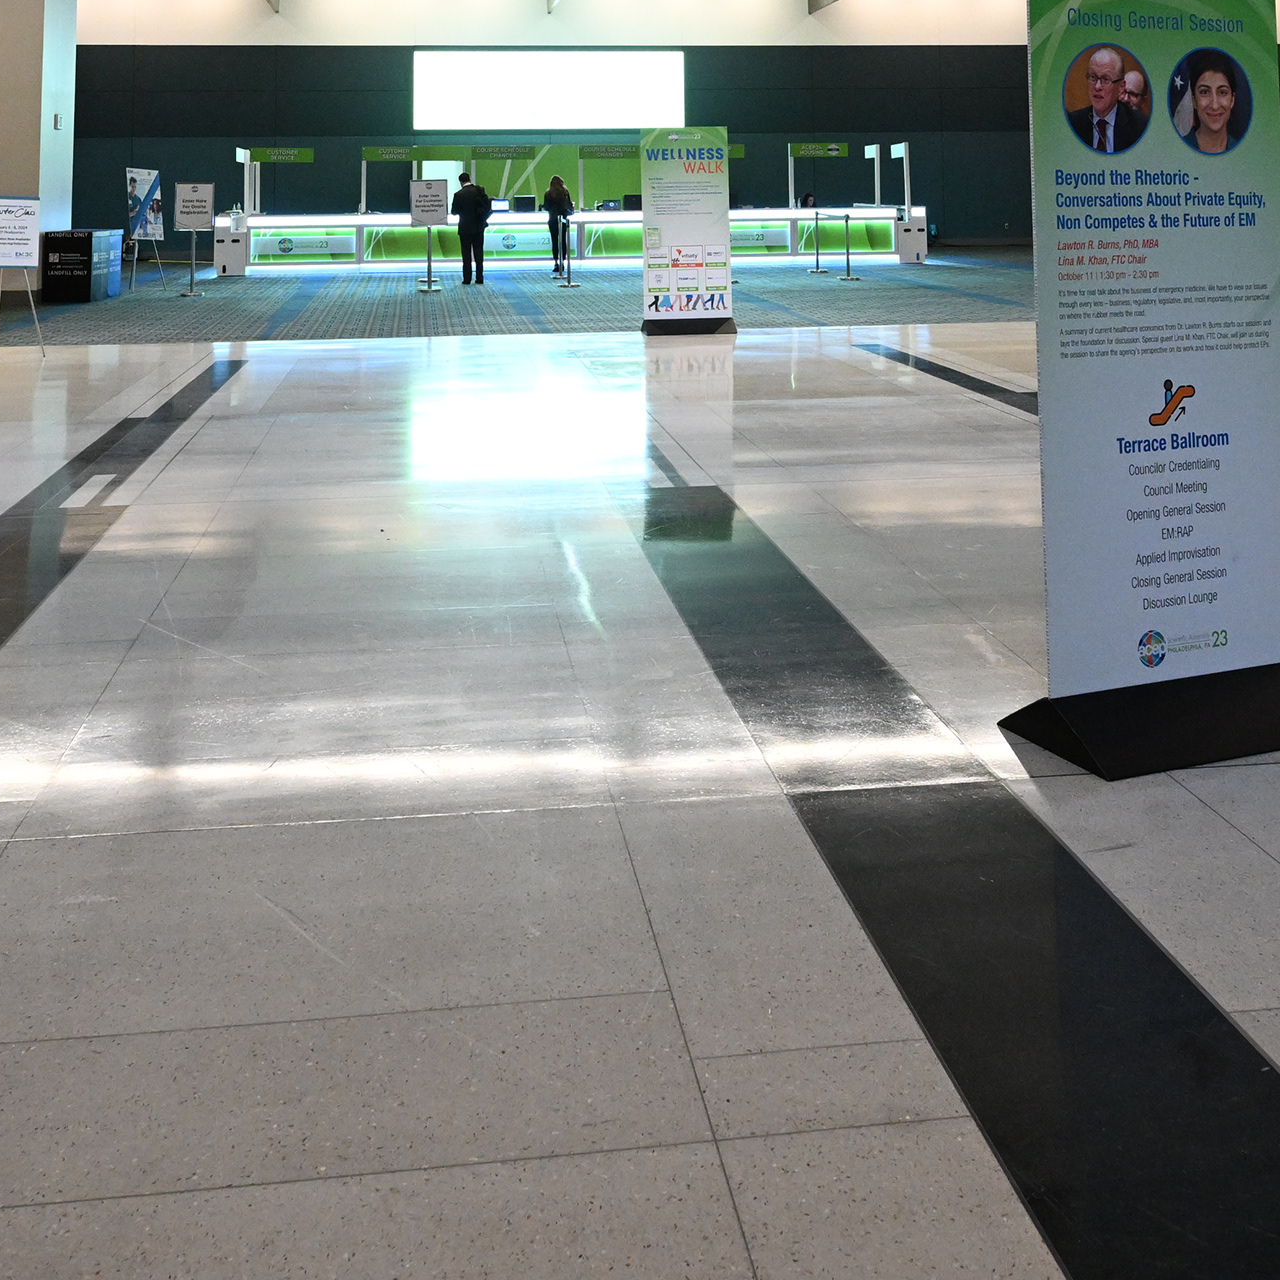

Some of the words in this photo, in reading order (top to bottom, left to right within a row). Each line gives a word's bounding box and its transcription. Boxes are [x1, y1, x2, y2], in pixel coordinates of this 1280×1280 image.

[1068, 8, 1122, 32] Closing
[1128, 11, 1184, 30] General
[1189, 14, 1243, 32] Session
[646, 148, 724, 161] WELLNESS
[683, 161, 724, 174] WALK
[1055, 170, 1105, 189] Beyond
[1110, 170, 1131, 185] the
[1135, 170, 1190, 186] Rhetoric
[1056, 192, 1143, 208] Conversations
[1146, 192, 1181, 206] About
[1185, 192, 1225, 206] Private
[1228, 192, 1266, 208] Equity,
[1057, 215, 1081, 229] Non
[1085, 214, 1145, 232] Competes
[1149, 214, 1158, 228] &
[1161, 214, 1179, 228] the
[1183, 214, 1220, 228] Future
[1224, 213, 1235, 226] of
[1238, 213, 1256, 226] EM
[1058, 241, 1085, 251] Lawton
[1087, 240, 1095, 249] R.
[1098, 240, 1122, 250] Burns,
[1123, 239, 1140, 250] PhD,
[1142, 239, 1159, 248] MBA
[1058, 256, 1074, 266] Lina
[1076, 256, 1085, 265] M.
[1088, 256, 1109, 266] Khan,
[1111, 255, 1126, 264] FTC
[1127, 255, 1147, 264] Chair
[1058, 272, 1083, 281] October
[1086, 271, 1094, 280] 11
[1100, 271, 1114, 279] 1:30
[1116, 272, 1126, 280] pm
[1133, 270, 1147, 279] 2:30
[1149, 271, 1159, 279] pm
[1117, 438, 1166, 454] Terrace
[1171, 432, 1229, 449] Ballroom
[1129, 463, 1166, 476] Councilor
[1169, 458, 1220, 472] Credentialing
[1144, 483, 1173, 497] Council
[1176, 481, 1207, 493] Meeting
[1127, 508, 1160, 523] Opening
[1163, 503, 1193, 517] General
[1195, 501, 1226, 514] Session
[1162, 525, 1194, 540] EM:RAP
[1136, 551, 1166, 567] Applied
[1168, 546, 1220, 562] Improvisation
[1132, 576, 1161, 588] Closing
[1164, 570, 1194, 585] General
[1196, 567, 1227, 580] Session
[1143, 595, 1186, 610] Discussion
[1188, 592, 1218, 604] Lounge
[1212, 630, 1228, 648] 23
